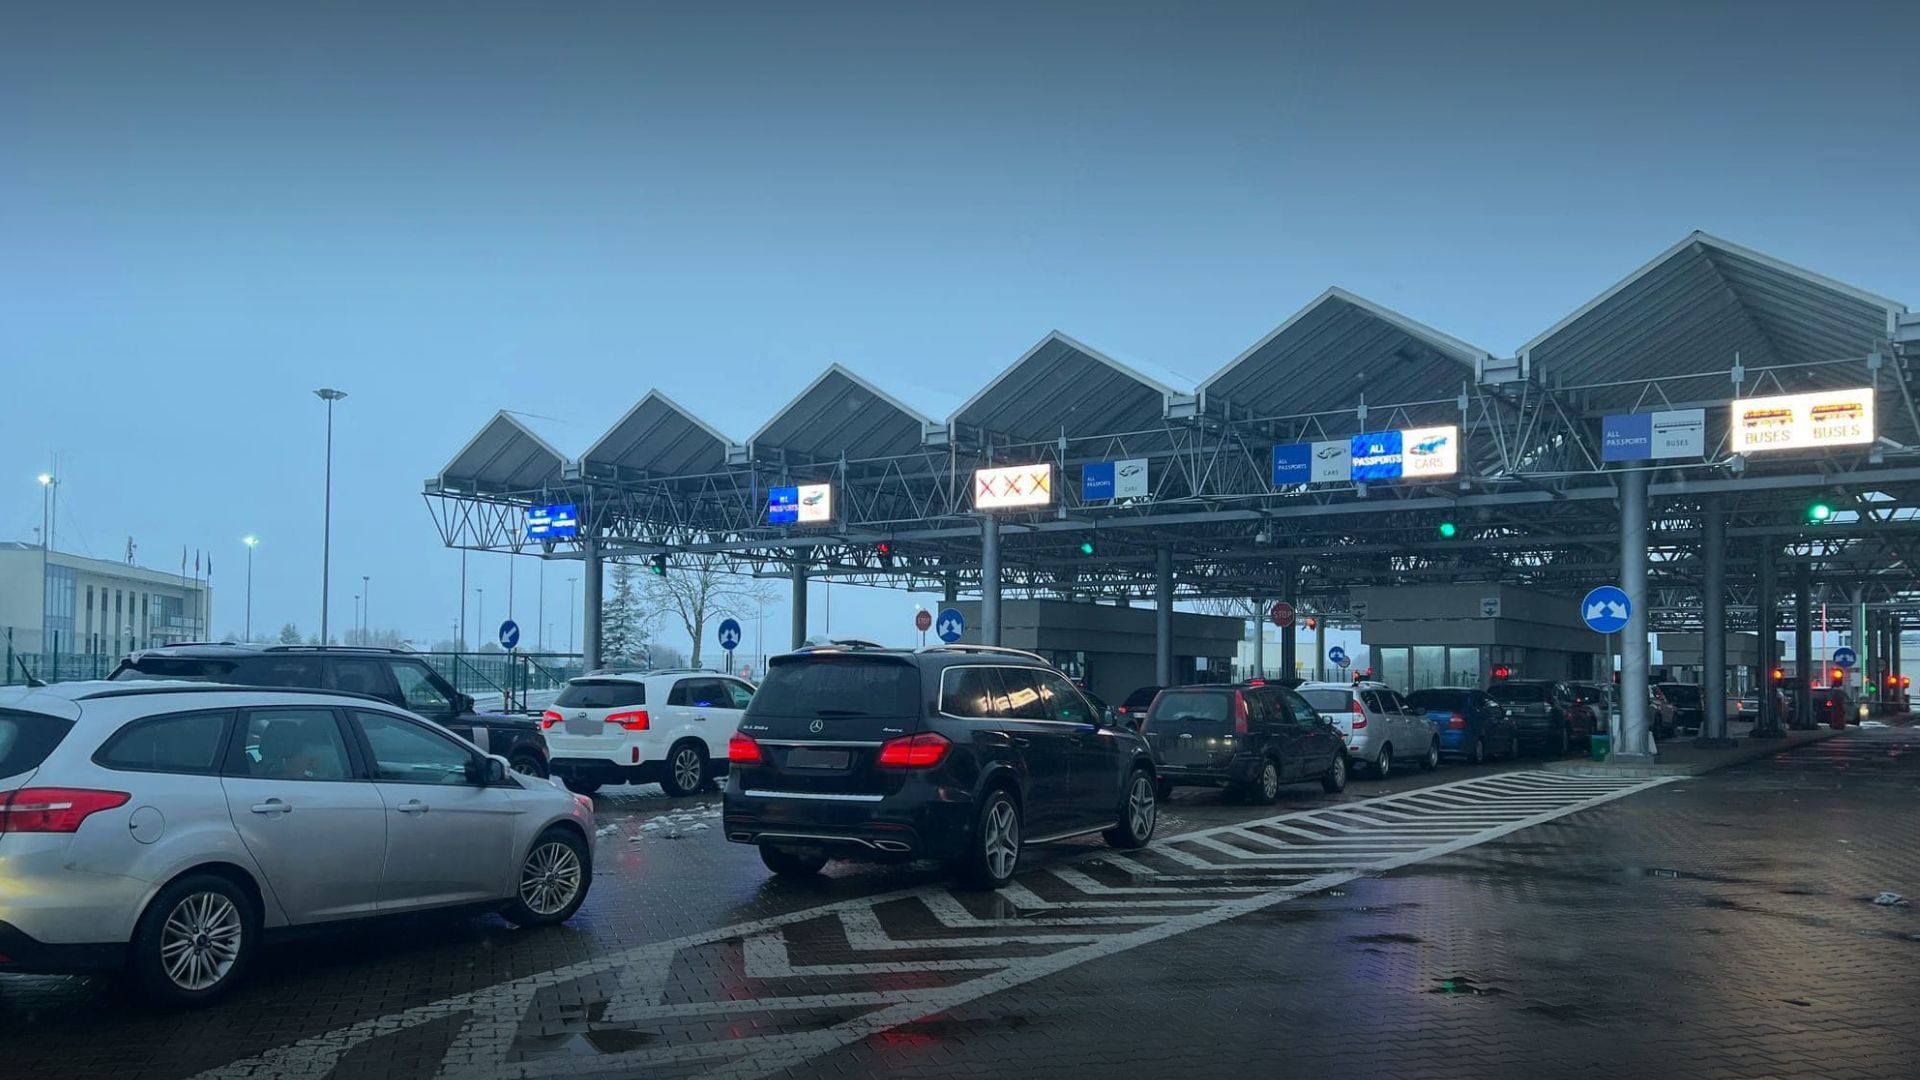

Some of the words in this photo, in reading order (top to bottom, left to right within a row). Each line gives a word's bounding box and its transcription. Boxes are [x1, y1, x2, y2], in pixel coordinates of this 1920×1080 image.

[1745, 429, 1791, 444] BUSES
[1813, 424, 1860, 439] BUSES
[1607, 437, 1647, 446] PASSPORTS
[1666, 439, 1689, 447] BUSES
[1369, 444, 1385, 454] ALL
[1352, 454, 1402, 467] PASSPORTS
[1414, 457, 1443, 469] CARS
[1278, 463, 1307, 471] PASSPORTS
[1273, 610, 1292, 618] STOP
